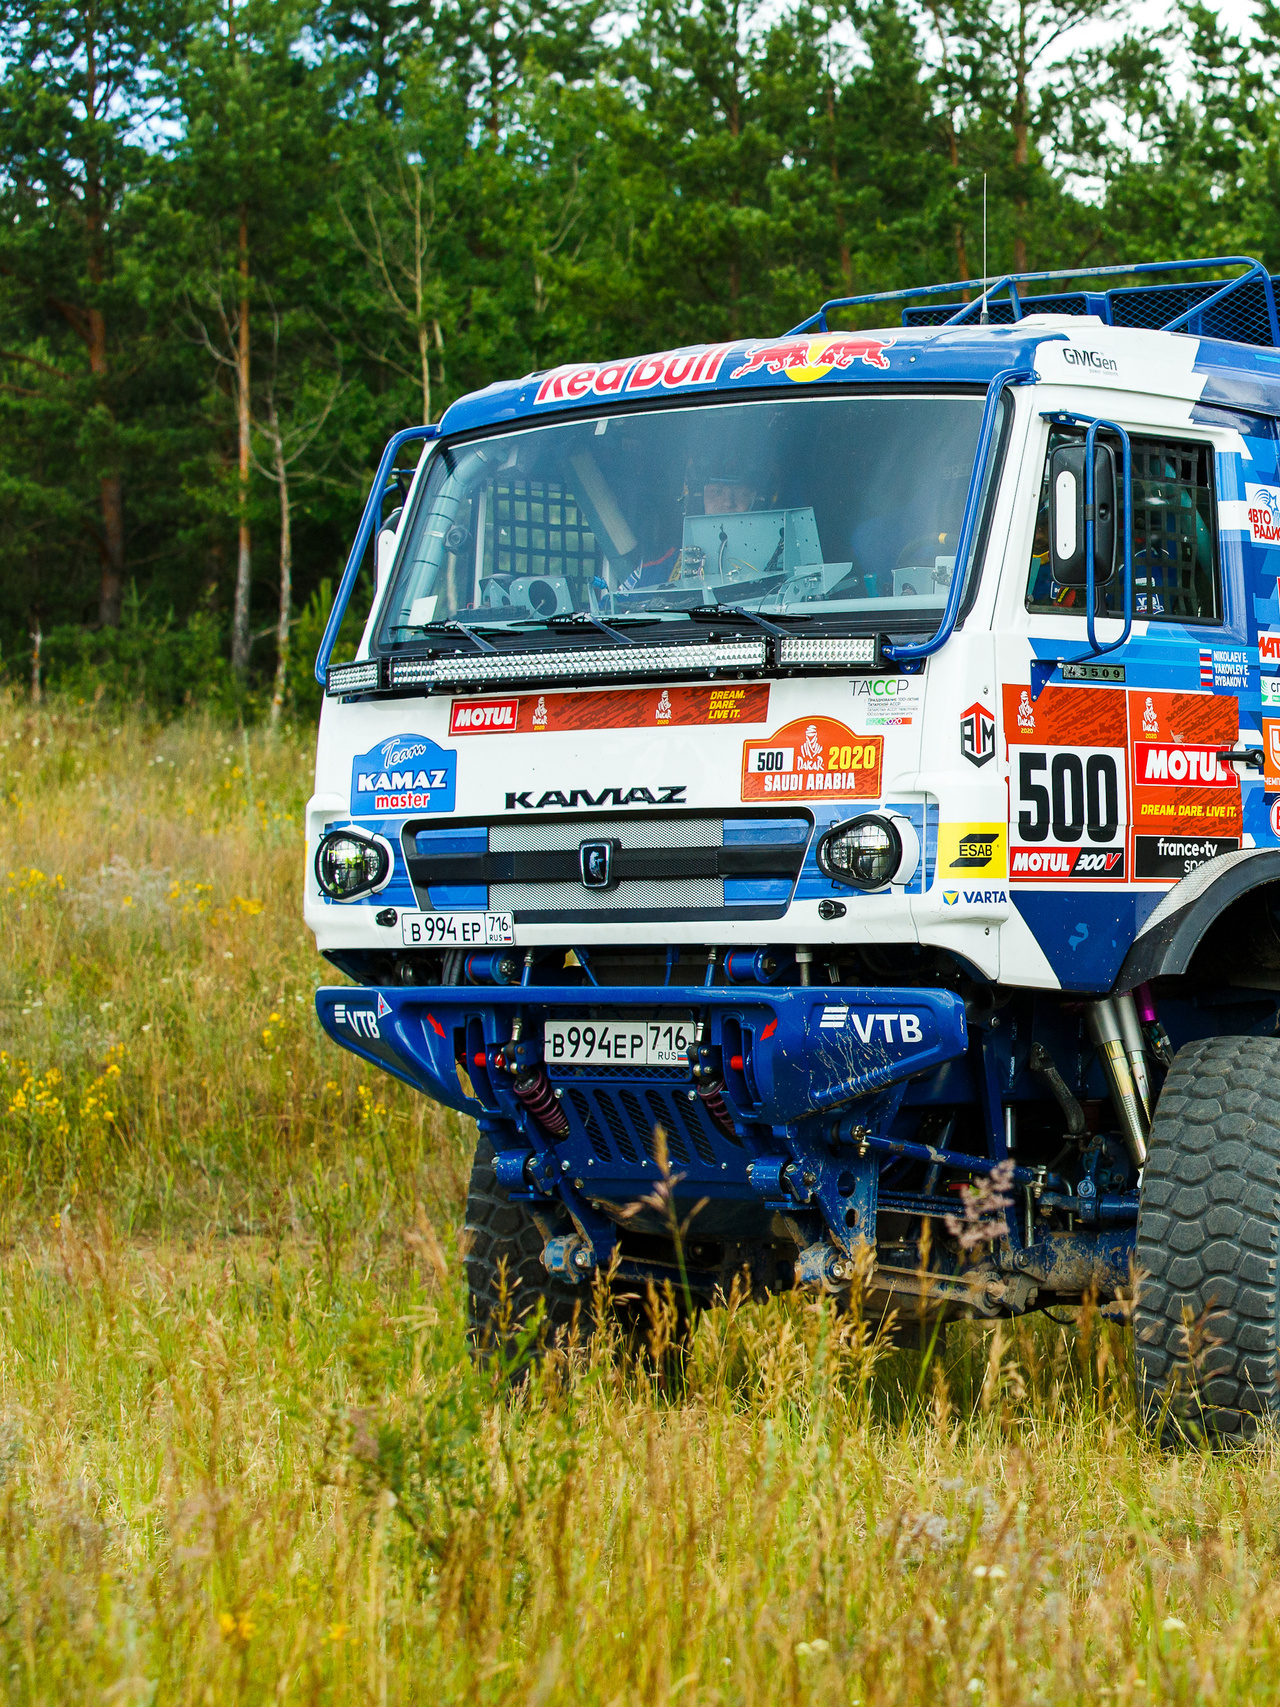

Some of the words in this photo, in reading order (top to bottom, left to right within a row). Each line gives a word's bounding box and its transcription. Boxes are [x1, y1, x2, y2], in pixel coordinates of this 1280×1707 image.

[1063, 348, 1118, 371] GMGen
[535, 358, 642, 403] Red
[628, 344, 741, 389] Bull
[1248, 508, 1271, 525] АВТО
[1213, 651, 1241, 663] NIKOLAEV
[1243, 652, 1248, 663] E.
[1214, 664, 1242, 675] YAKOVLEV
[1244, 665, 1250, 676] E.
[1215, 676, 1241, 688] RYBAKOV
[1242, 677, 1249, 688] V.
[710, 690, 746, 700] DREAM.
[708, 710, 728, 719] LIVE
[730, 709, 741, 718] IT.
[709, 700, 736, 710] DARE.
[455, 707, 514, 727] MOTUL
[382, 739, 426, 768] Team
[757, 752, 783, 771] 500
[828, 746, 876, 770] 2020
[797, 756, 824, 771] DAKAR
[1145, 750, 1228, 781] MOTUL
[358, 770, 447, 792] KAMAZ
[764, 774, 803, 791] SAUDI
[806, 772, 856, 790] ARABIA
[375, 792, 430, 808] master
[505, 786, 687, 810] KAMAZ
[1018, 752, 1118, 842] 500
[1141, 804, 1177, 816] DREAM.
[1178, 806, 1205, 816] DARE.
[1206, 807, 1225, 817] LIVE
[1226, 806, 1237, 817] IT.
[959, 844, 993, 857] ESAB
[1012, 853, 1070, 871] MOTUL
[1075, 853, 1121, 871] 300V
[963, 891, 1007, 904] VARTA
[489, 916, 509, 932] 716
[346, 1011, 380, 1038] VTB
[851, 1013, 923, 1043] VTB
[650, 1026, 687, 1051] 716
[658, 1051, 677, 1060] RUS
